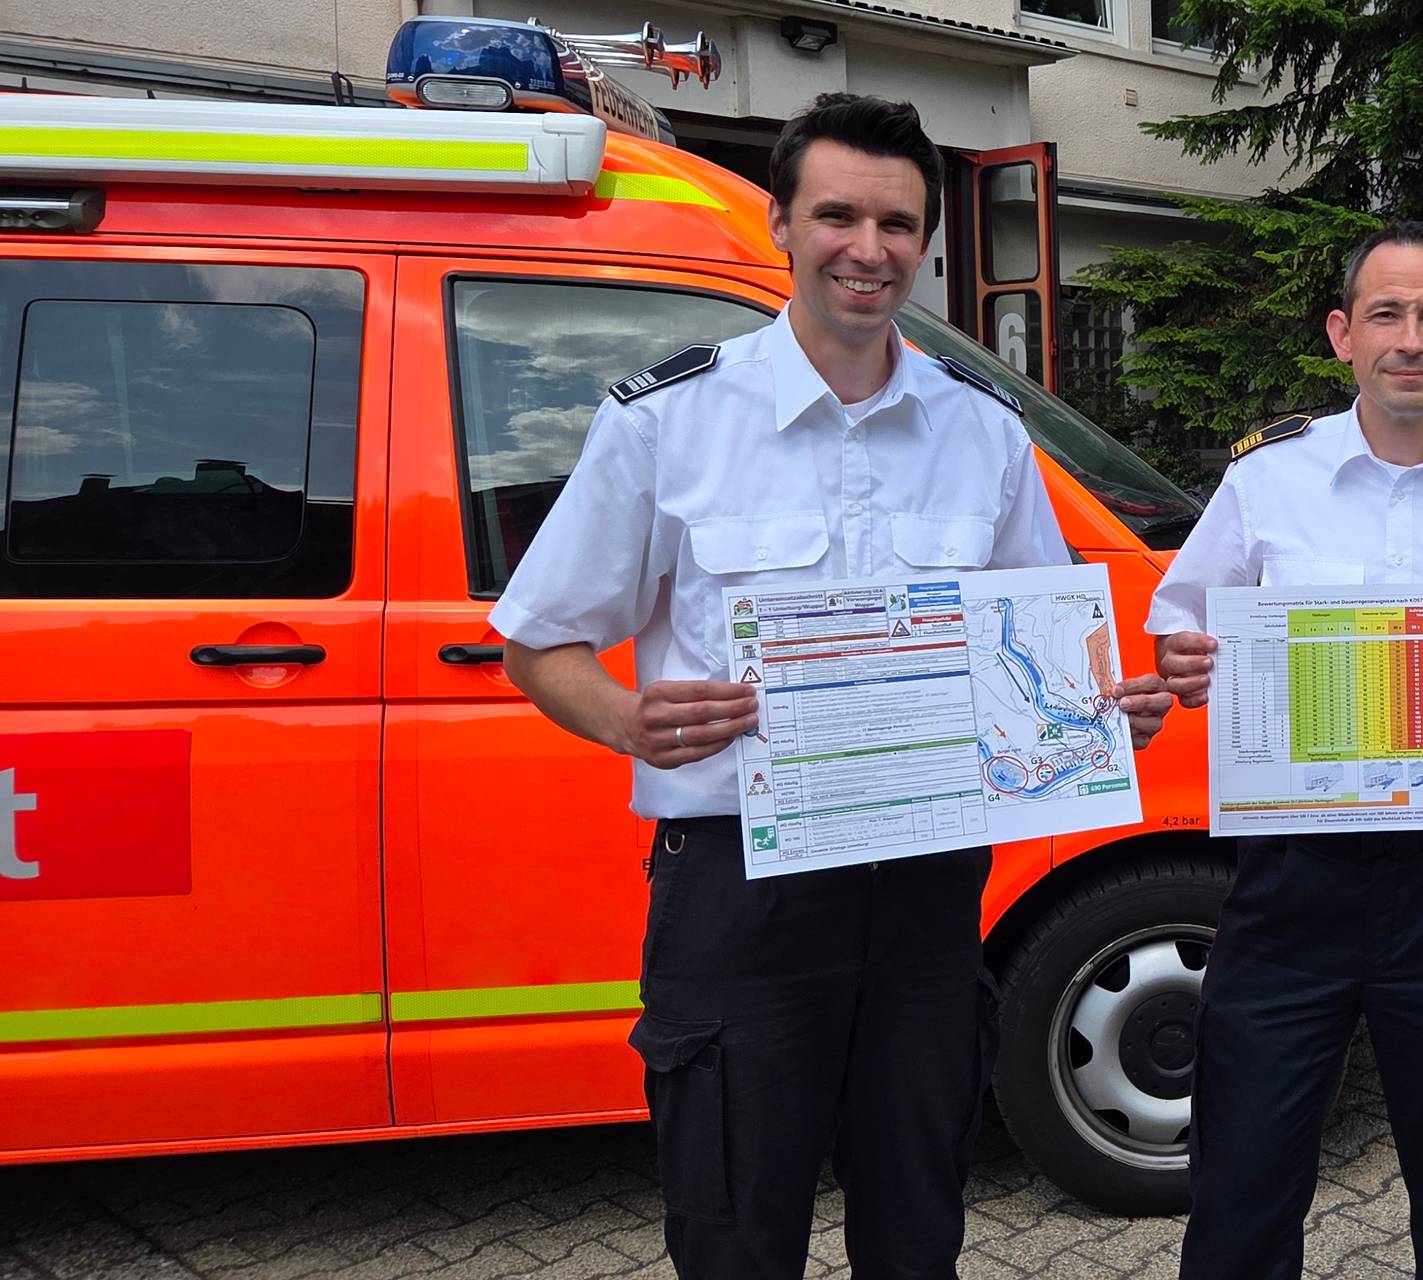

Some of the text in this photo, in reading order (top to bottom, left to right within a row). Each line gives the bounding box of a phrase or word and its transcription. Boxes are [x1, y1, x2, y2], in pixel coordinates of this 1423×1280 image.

[998, 312, 1027, 376] 6
[1031, 756, 1043, 765] G3
[1107, 764, 1119, 772] G2
[988, 794, 1000, 802] G4
[1163, 816, 1200, 827] 4,2 bar
